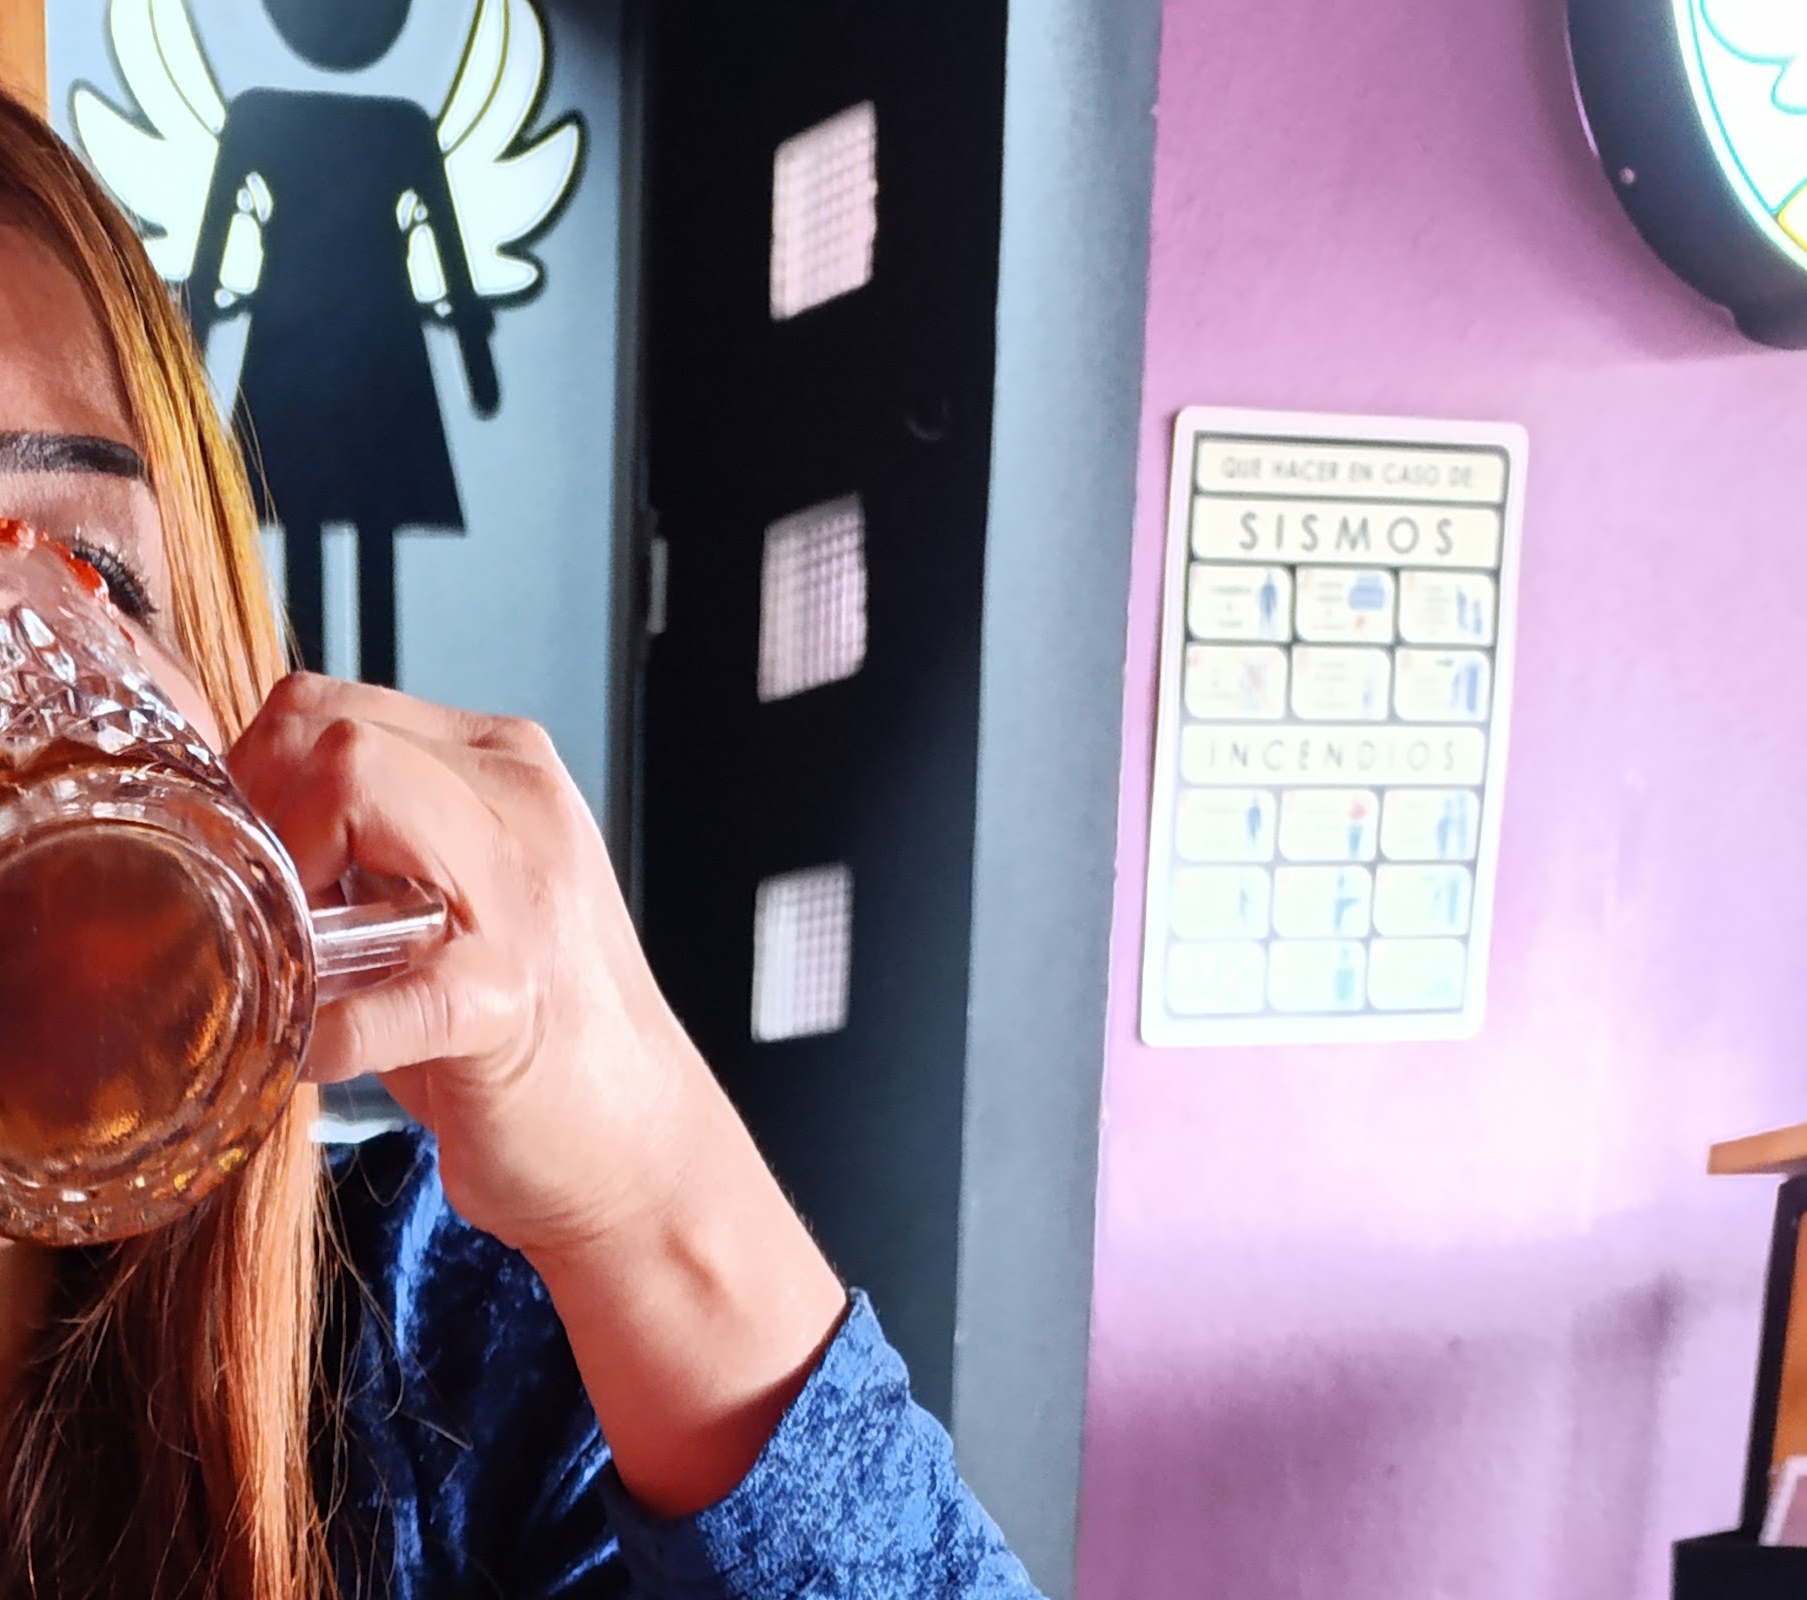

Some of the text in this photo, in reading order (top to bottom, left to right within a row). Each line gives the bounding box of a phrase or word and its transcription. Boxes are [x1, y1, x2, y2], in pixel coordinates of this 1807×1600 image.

[1272, 459, 1339, 482] HACER
[1349, 461, 1374, 483] EN
[1383, 463, 1440, 486] CASO
[1448, 466, 1473, 488] DE
[1239, 511, 1454, 556] SISMOS
[1209, 739, 1456, 772] INCENDIOS
